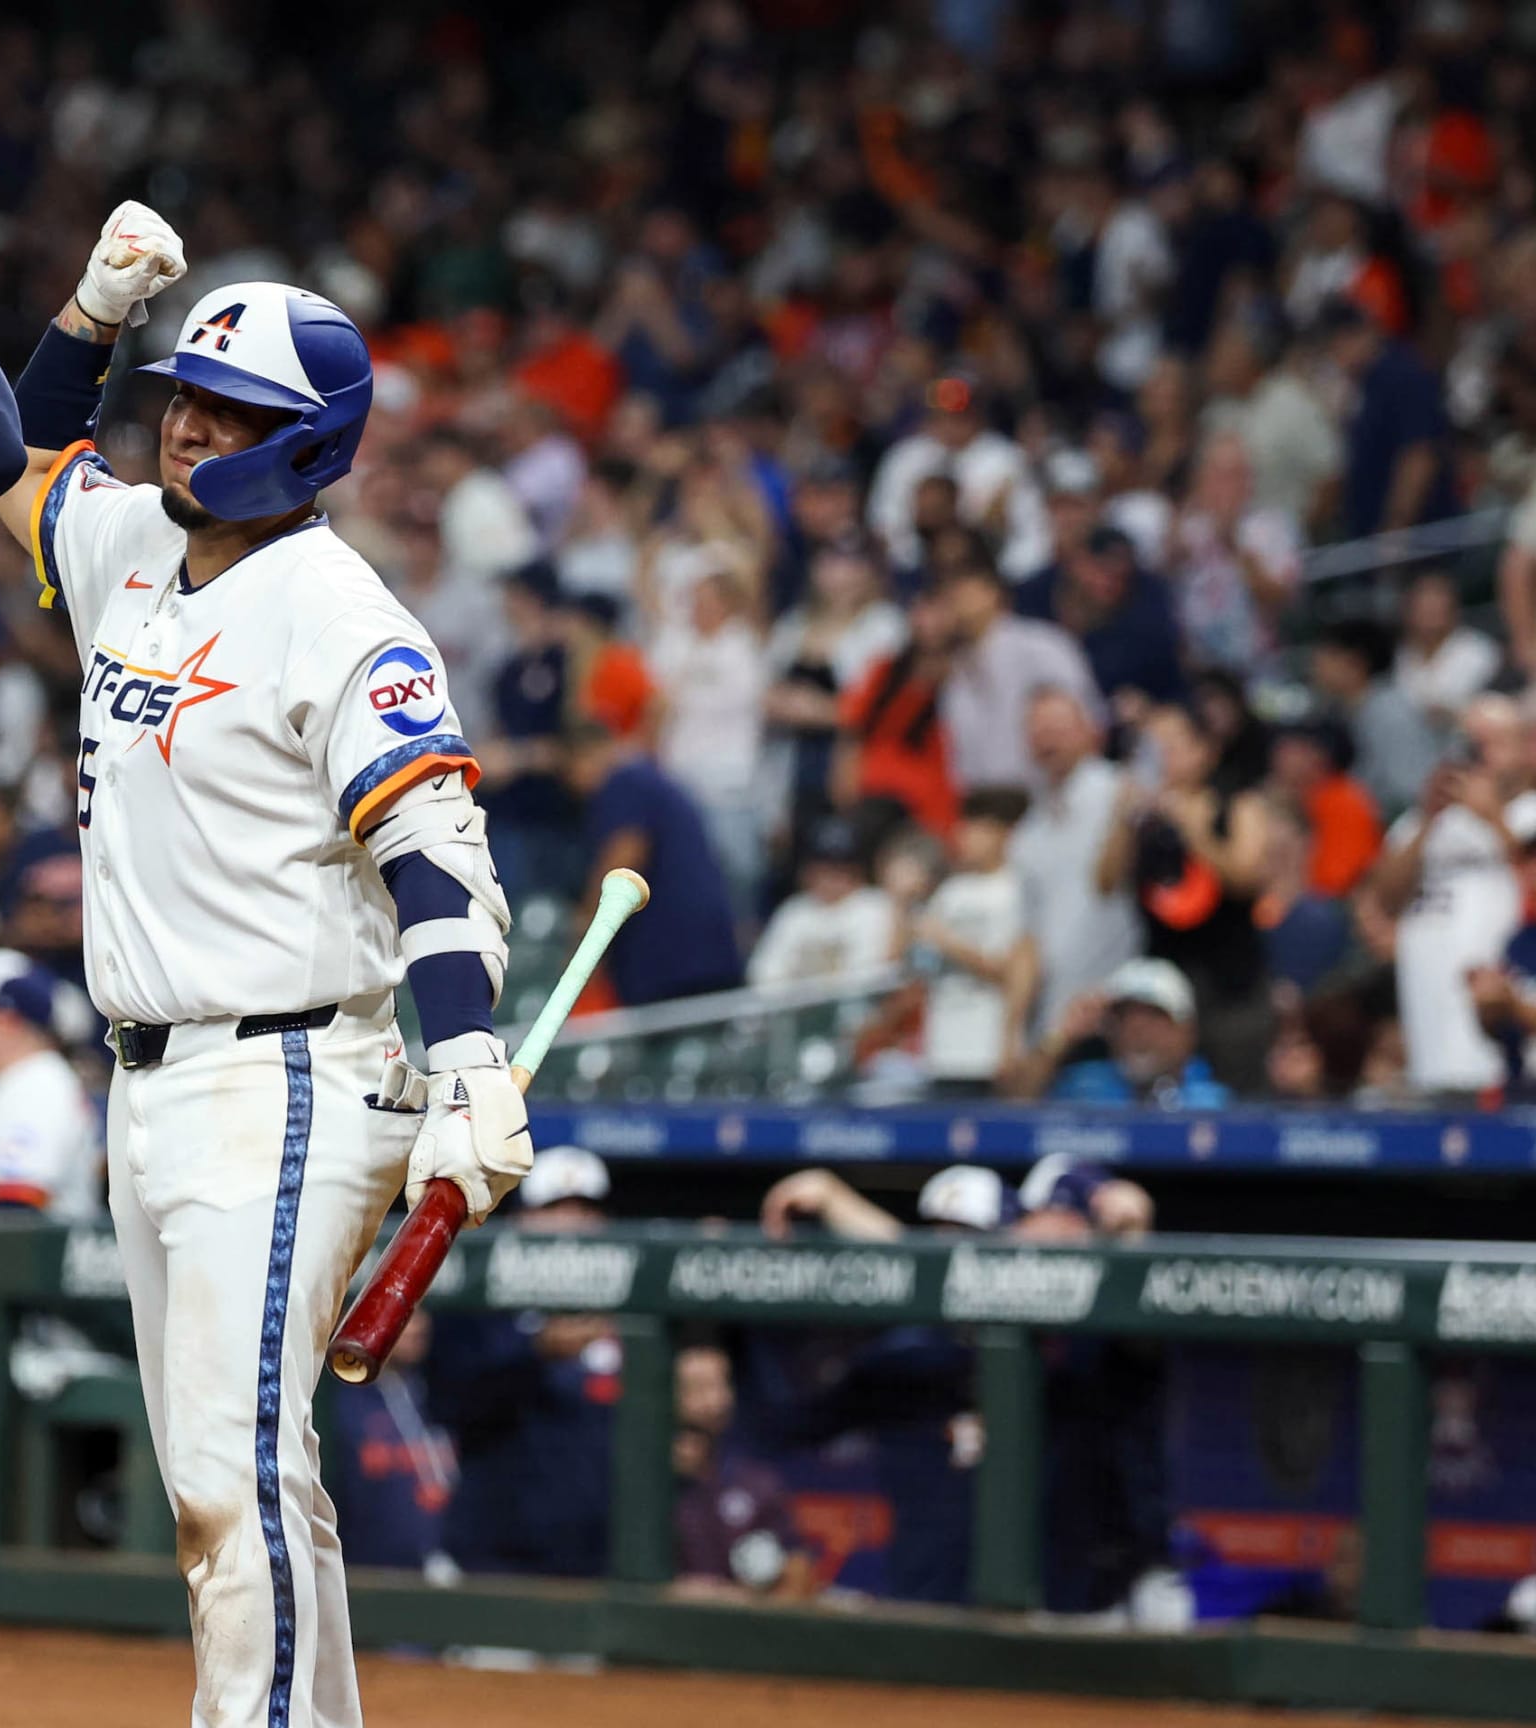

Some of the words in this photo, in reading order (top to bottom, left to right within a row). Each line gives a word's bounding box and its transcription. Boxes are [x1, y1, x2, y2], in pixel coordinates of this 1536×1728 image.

[81, 651, 183, 727] TROS
[369, 674, 435, 710] OXY
[670, 1248, 914, 1304] ACADEMY.COM
[1140, 1260, 1406, 1323] ACADEMY.COM
